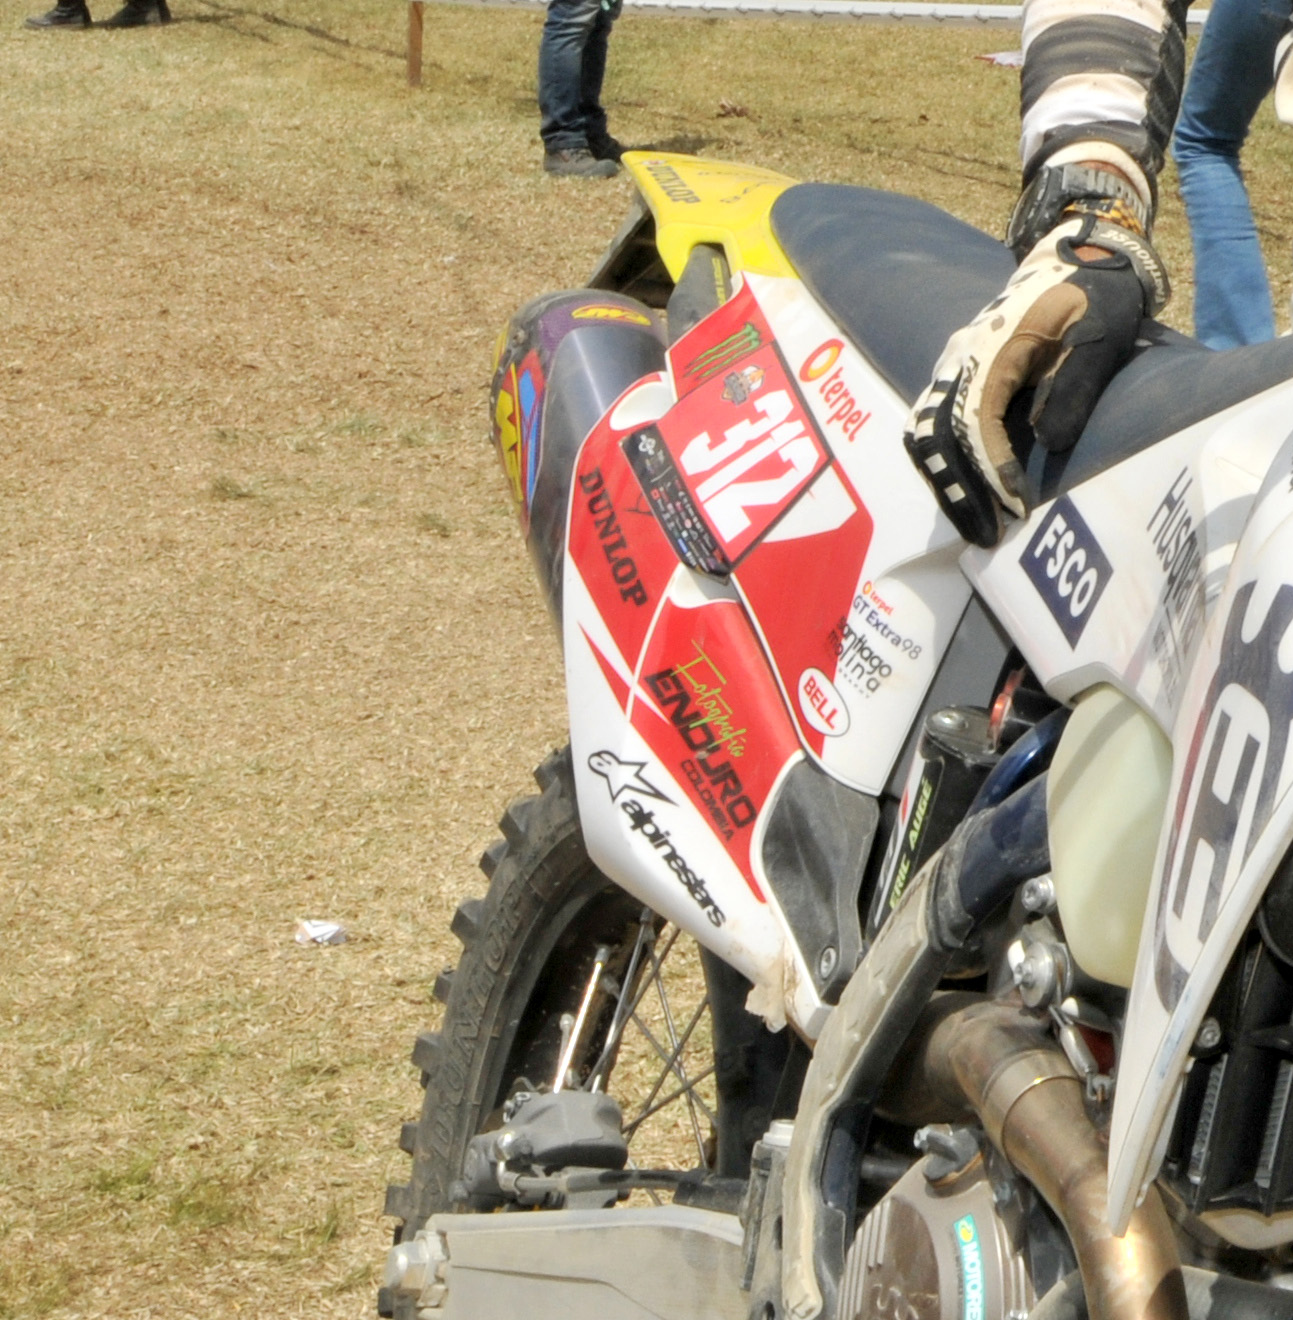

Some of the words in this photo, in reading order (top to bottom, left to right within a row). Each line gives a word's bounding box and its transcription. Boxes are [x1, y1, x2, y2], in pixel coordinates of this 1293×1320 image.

[679, 387, 834, 546] 312
[819, 365, 872, 443] terpel
[578, 465, 649, 607] DUNLOP
[1035, 511, 1097, 619] FSCO
[643, 667, 759, 830] ENDURO
[802, 675, 839, 731] BELL
[620, 798, 728, 929] alpinestars
